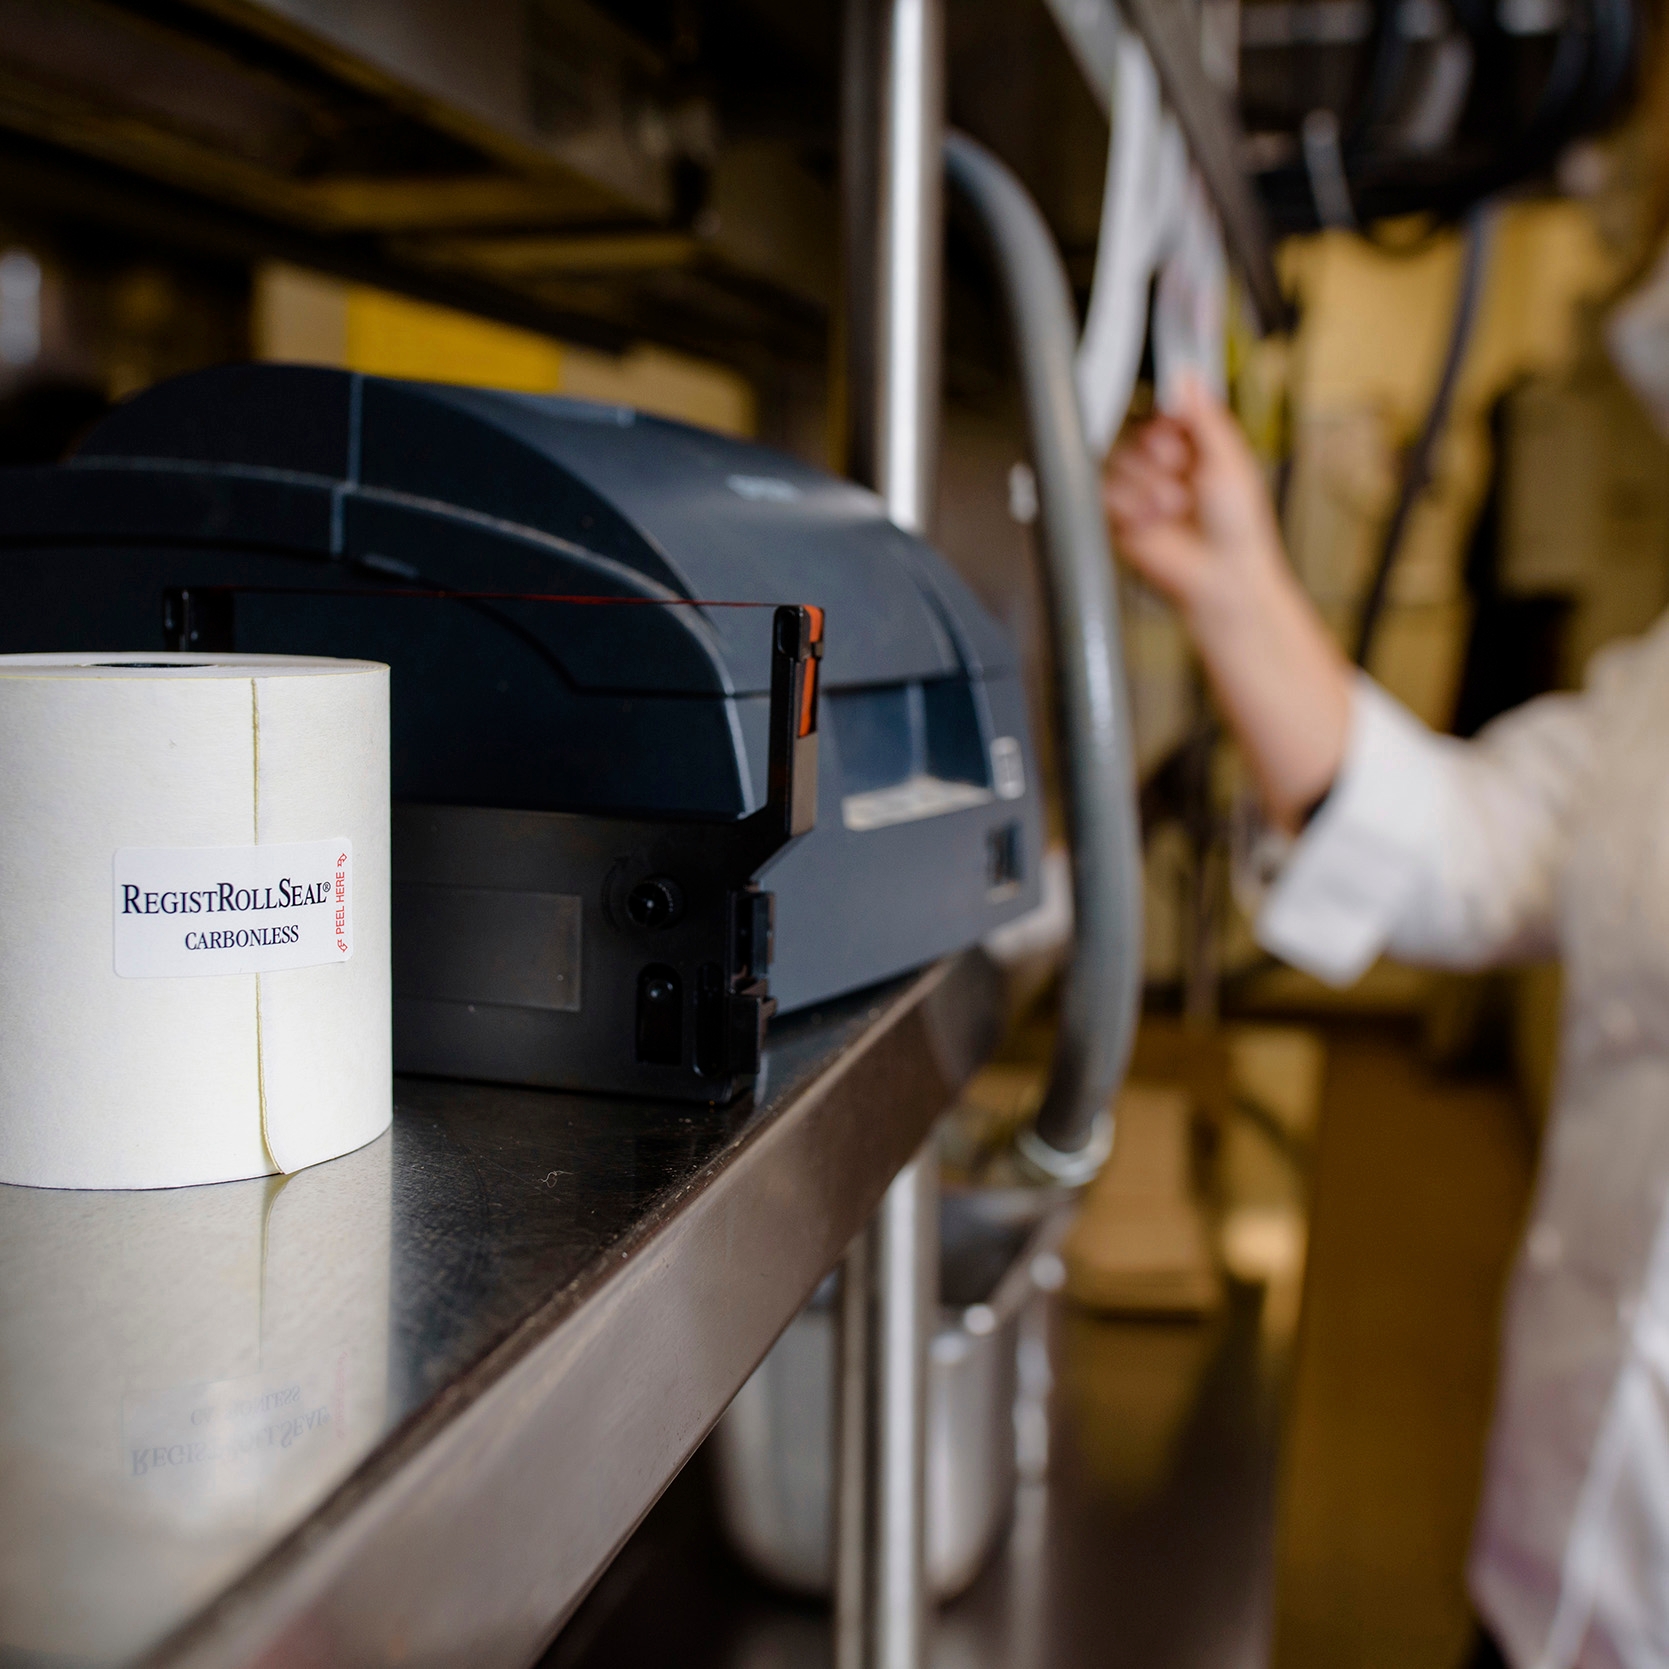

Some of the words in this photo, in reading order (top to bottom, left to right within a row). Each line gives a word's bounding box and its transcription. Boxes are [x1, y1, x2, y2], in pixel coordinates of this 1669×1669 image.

[336, 872, 345, 903] HERE
[336, 906, 345, 935] PEEL
[185, 925, 299, 950] CARBONLESS
